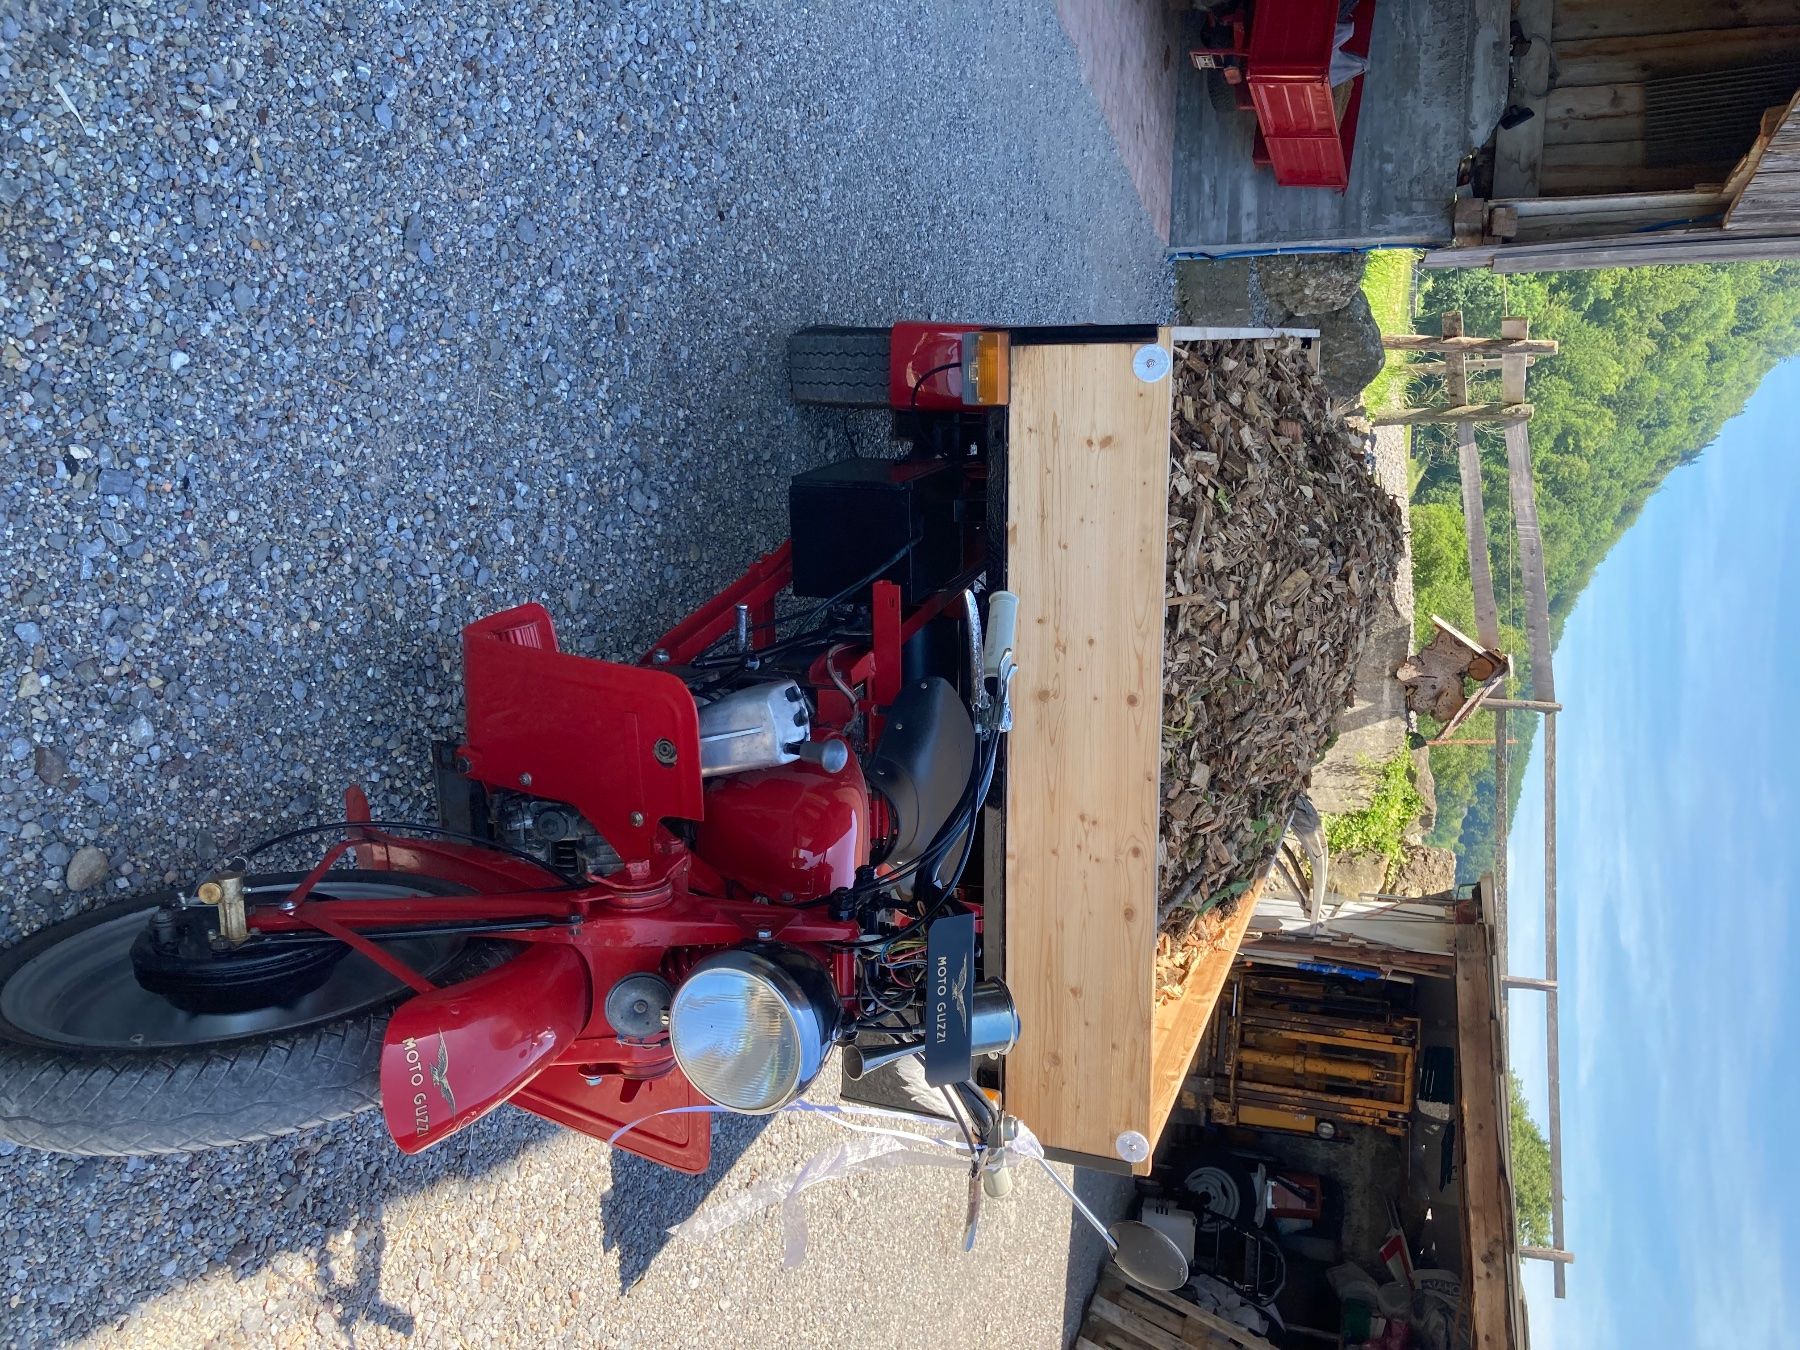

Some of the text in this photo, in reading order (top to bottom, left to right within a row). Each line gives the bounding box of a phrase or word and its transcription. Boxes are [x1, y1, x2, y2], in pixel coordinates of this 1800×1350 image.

[936, 956, 947, 1043] MOTO GUZZI
[402, 1037, 429, 1138] MOTO GUZZI
